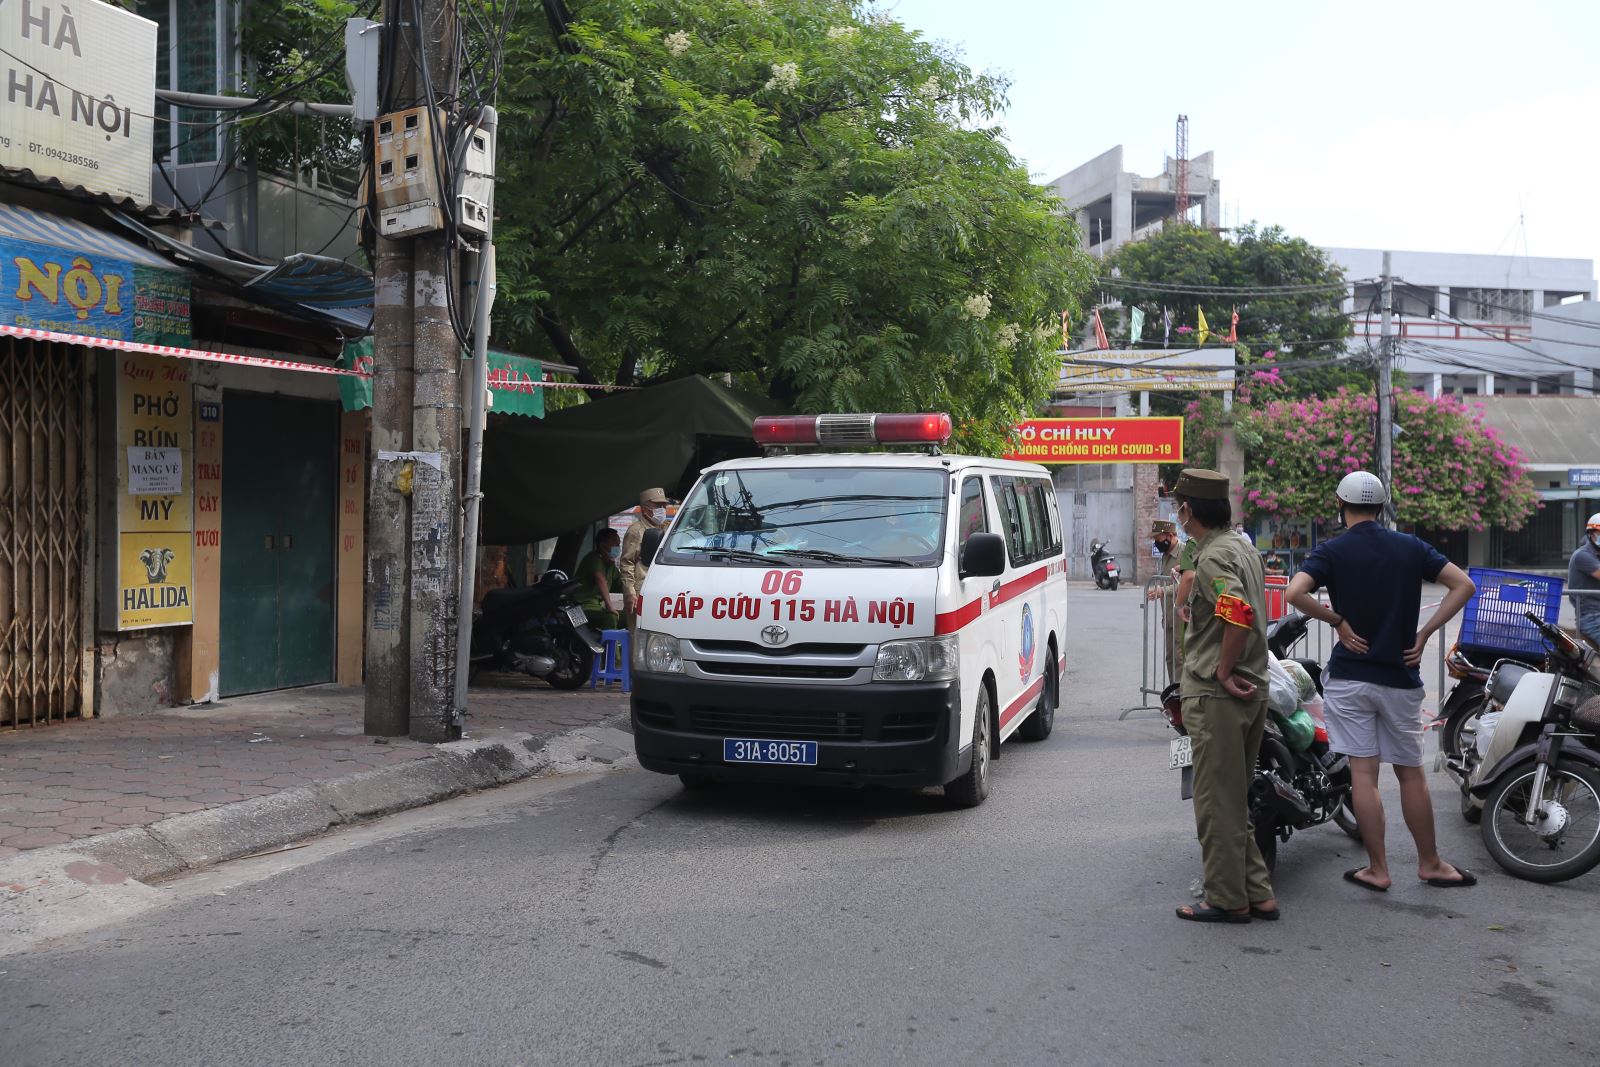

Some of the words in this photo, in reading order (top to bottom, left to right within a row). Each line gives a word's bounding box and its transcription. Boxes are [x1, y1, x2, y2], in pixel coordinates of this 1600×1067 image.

[22, 0, 82, 58] HÀ
[71, 89, 131, 142] NỘI
[14, 256, 123, 320] NỘI
[133, 390, 179, 418] PHỞ
[134, 425, 178, 447] BÚN
[1040, 425, 1071, 441] CHỈ
[1075, 427, 1116, 441] HUY
[1051, 441, 1089, 455] CHỐNG
[1092, 443, 1118, 458] DỊCH
[131, 464, 163, 474] MANG
[761, 569, 804, 596] 06
[123, 584, 190, 611] HALIDA
[659, 590, 704, 619] CẤP
[711, 592, 761, 621] CỨU
[771, 598, 815, 622] 115
[824, 595, 859, 623] HÀ
[867, 597, 915, 628] NỘI
[734, 742, 807, 763] 31A-8051
[1177, 737, 1190, 752] 29
